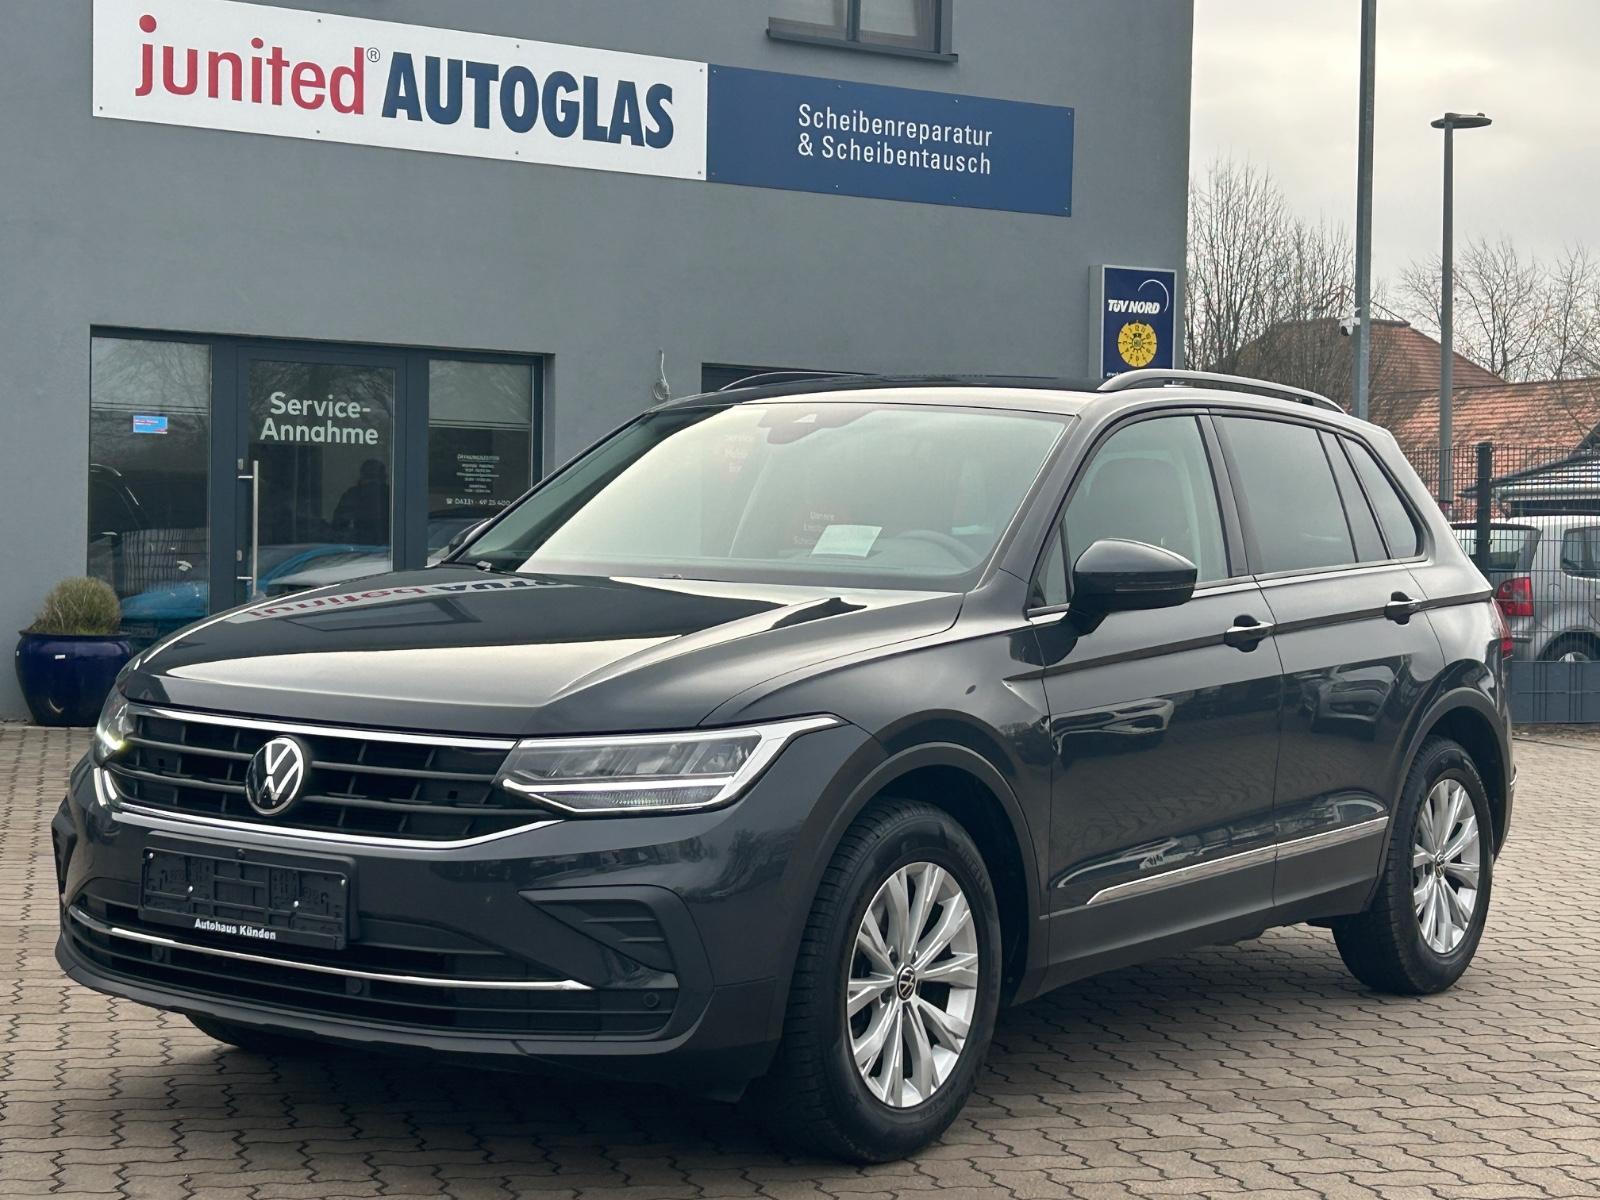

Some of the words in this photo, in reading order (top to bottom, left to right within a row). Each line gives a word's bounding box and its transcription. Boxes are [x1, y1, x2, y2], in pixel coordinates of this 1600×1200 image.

[381, 51, 674, 149] AUTOGLAS
[798, 103, 993, 147] Scheibenreparatur
[797, 132, 813, 156] &
[822, 136, 991, 175] Scheibentausch
[1108, 299, 1129, 313] TÜV
[1128, 300, 1160, 314] NORD
[270, 391, 371, 418] Service-
[260, 417, 379, 445] Annahme
[194, 918, 237, 934] Autohaus
[239, 925, 276, 940] Künden
